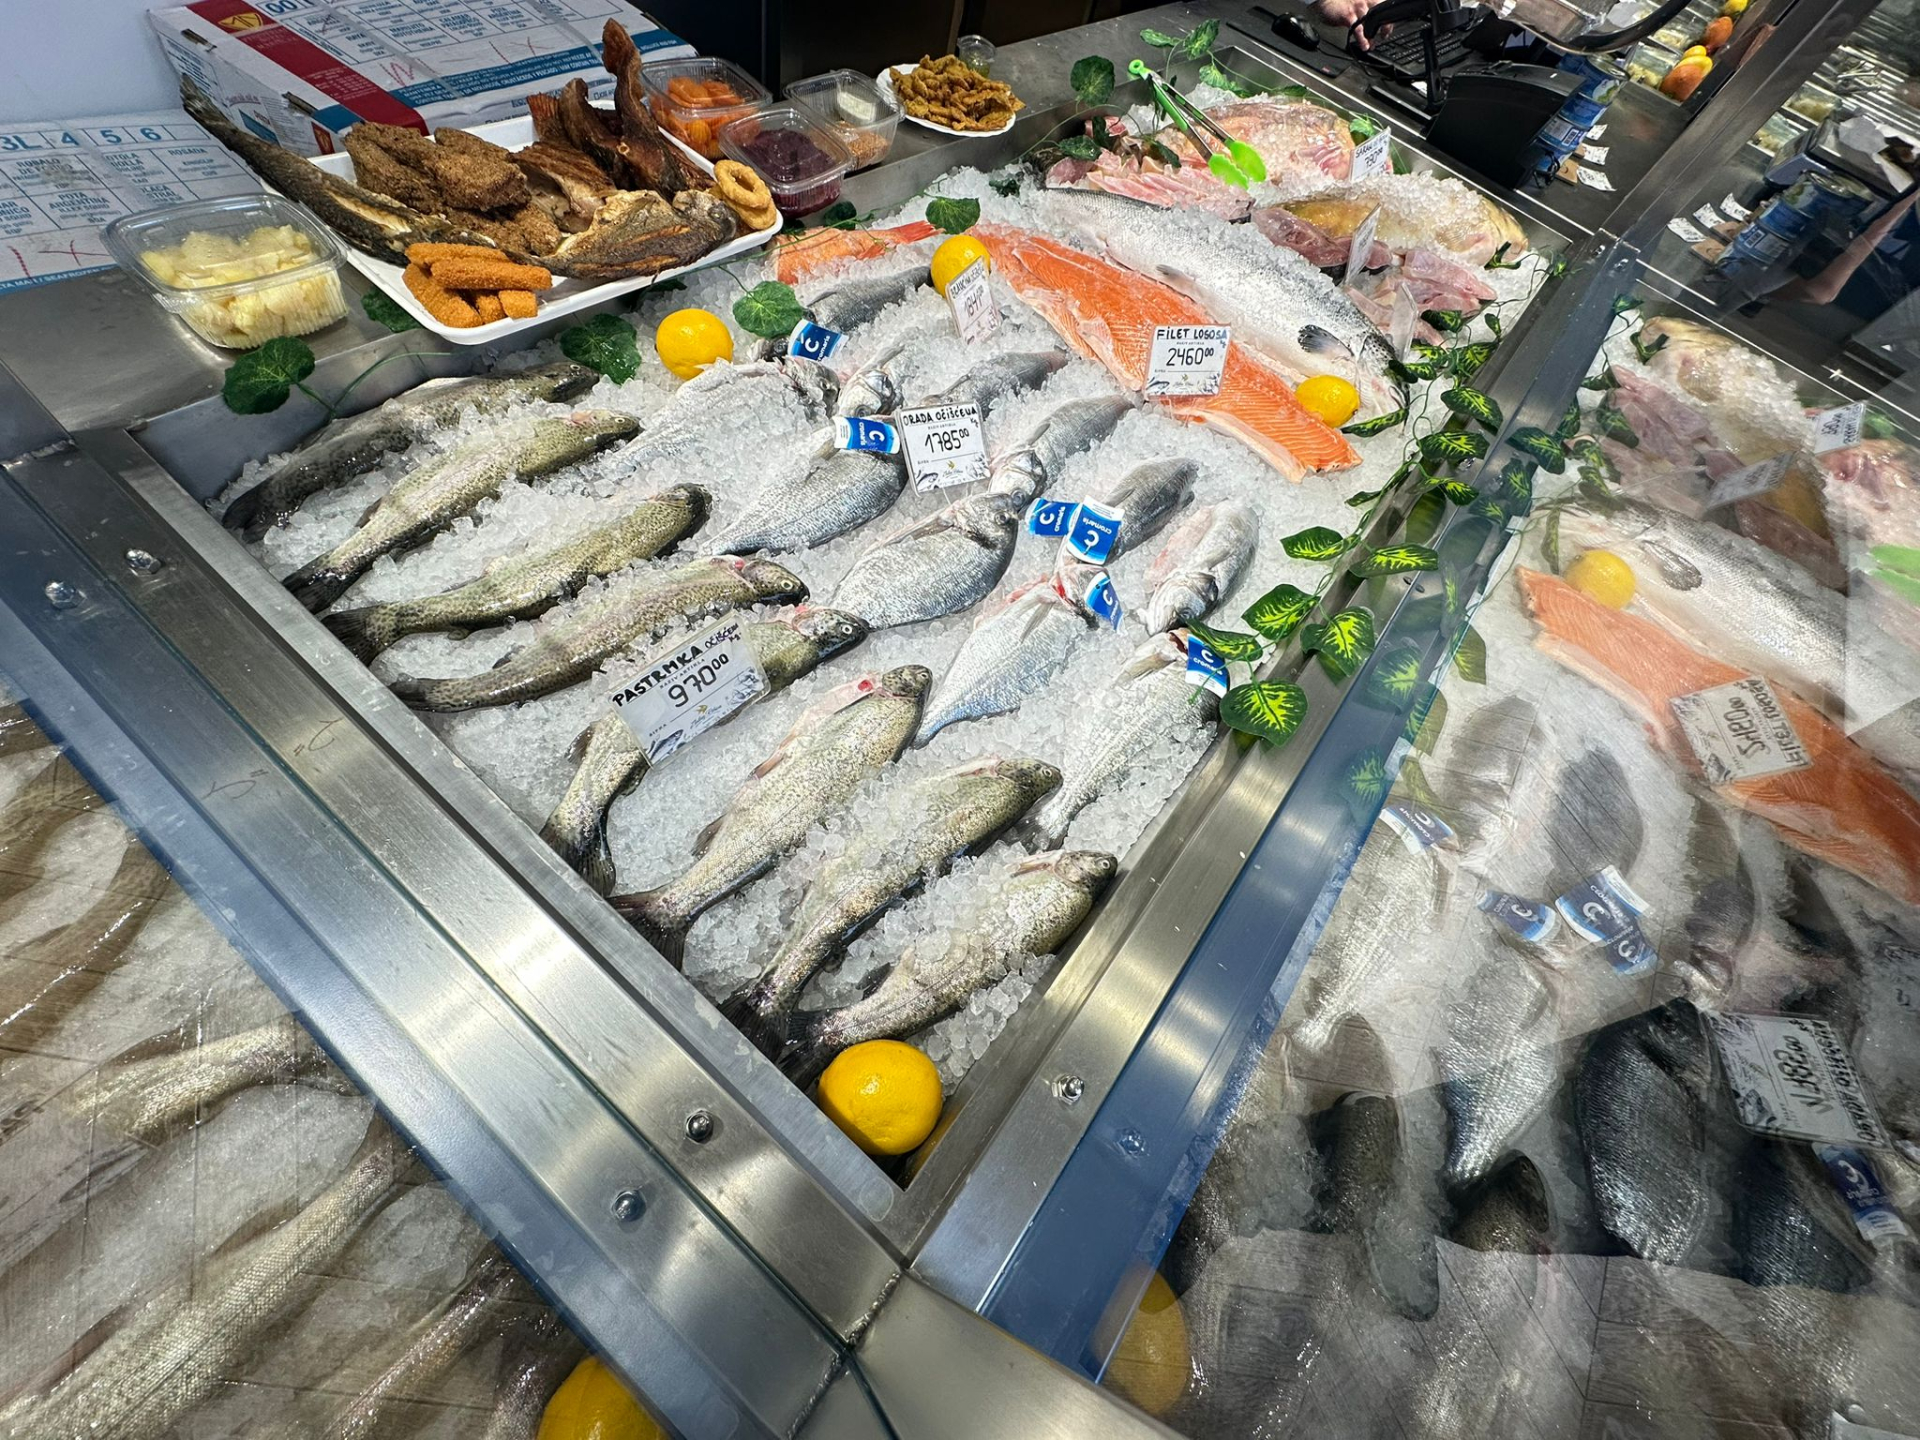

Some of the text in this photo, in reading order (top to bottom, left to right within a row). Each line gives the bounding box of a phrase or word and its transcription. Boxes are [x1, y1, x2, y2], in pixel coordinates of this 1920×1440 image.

[100, 129, 122, 144] 5
[140, 127, 162, 141] 6
[868, 430, 885, 442] C
[1039, 512, 1056, 525] C
[1082, 516, 1113, 535] cromaris
[612, 645, 704, 708] PASTRMKA
